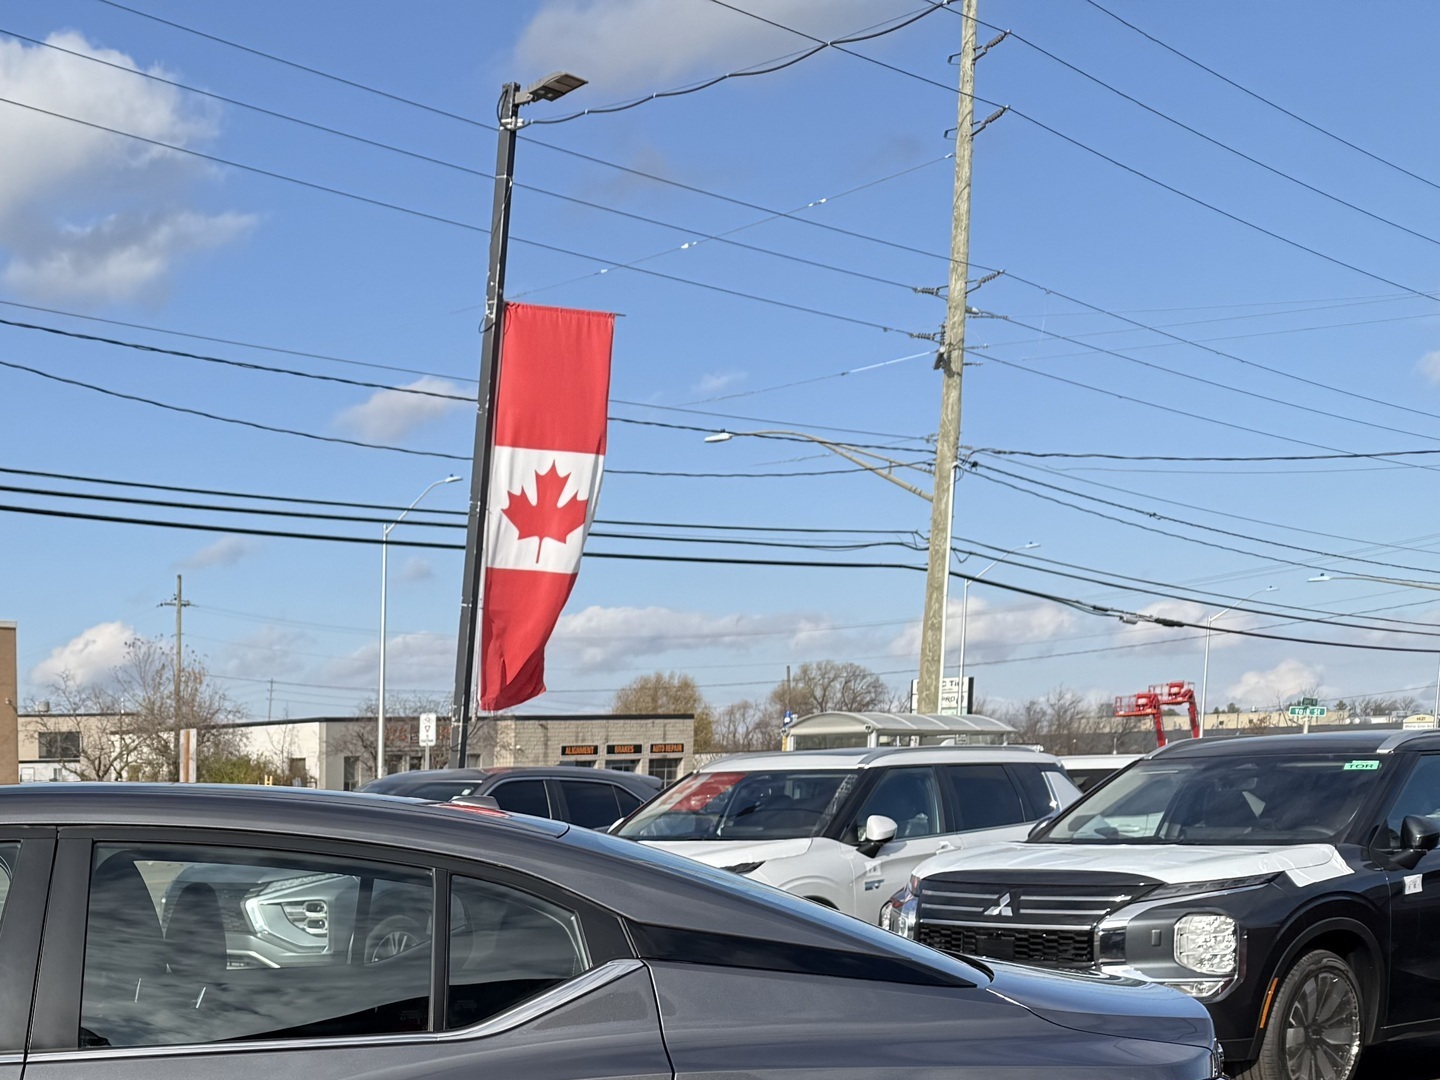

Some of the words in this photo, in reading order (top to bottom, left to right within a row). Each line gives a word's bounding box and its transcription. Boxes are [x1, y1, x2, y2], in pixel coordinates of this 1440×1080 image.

[565, 746, 594, 754] ALIGNMENT
[614, 745, 634, 753] BRAKES
[652, 744, 664, 752] AUTO
[665, 743, 683, 751] REPAIR
